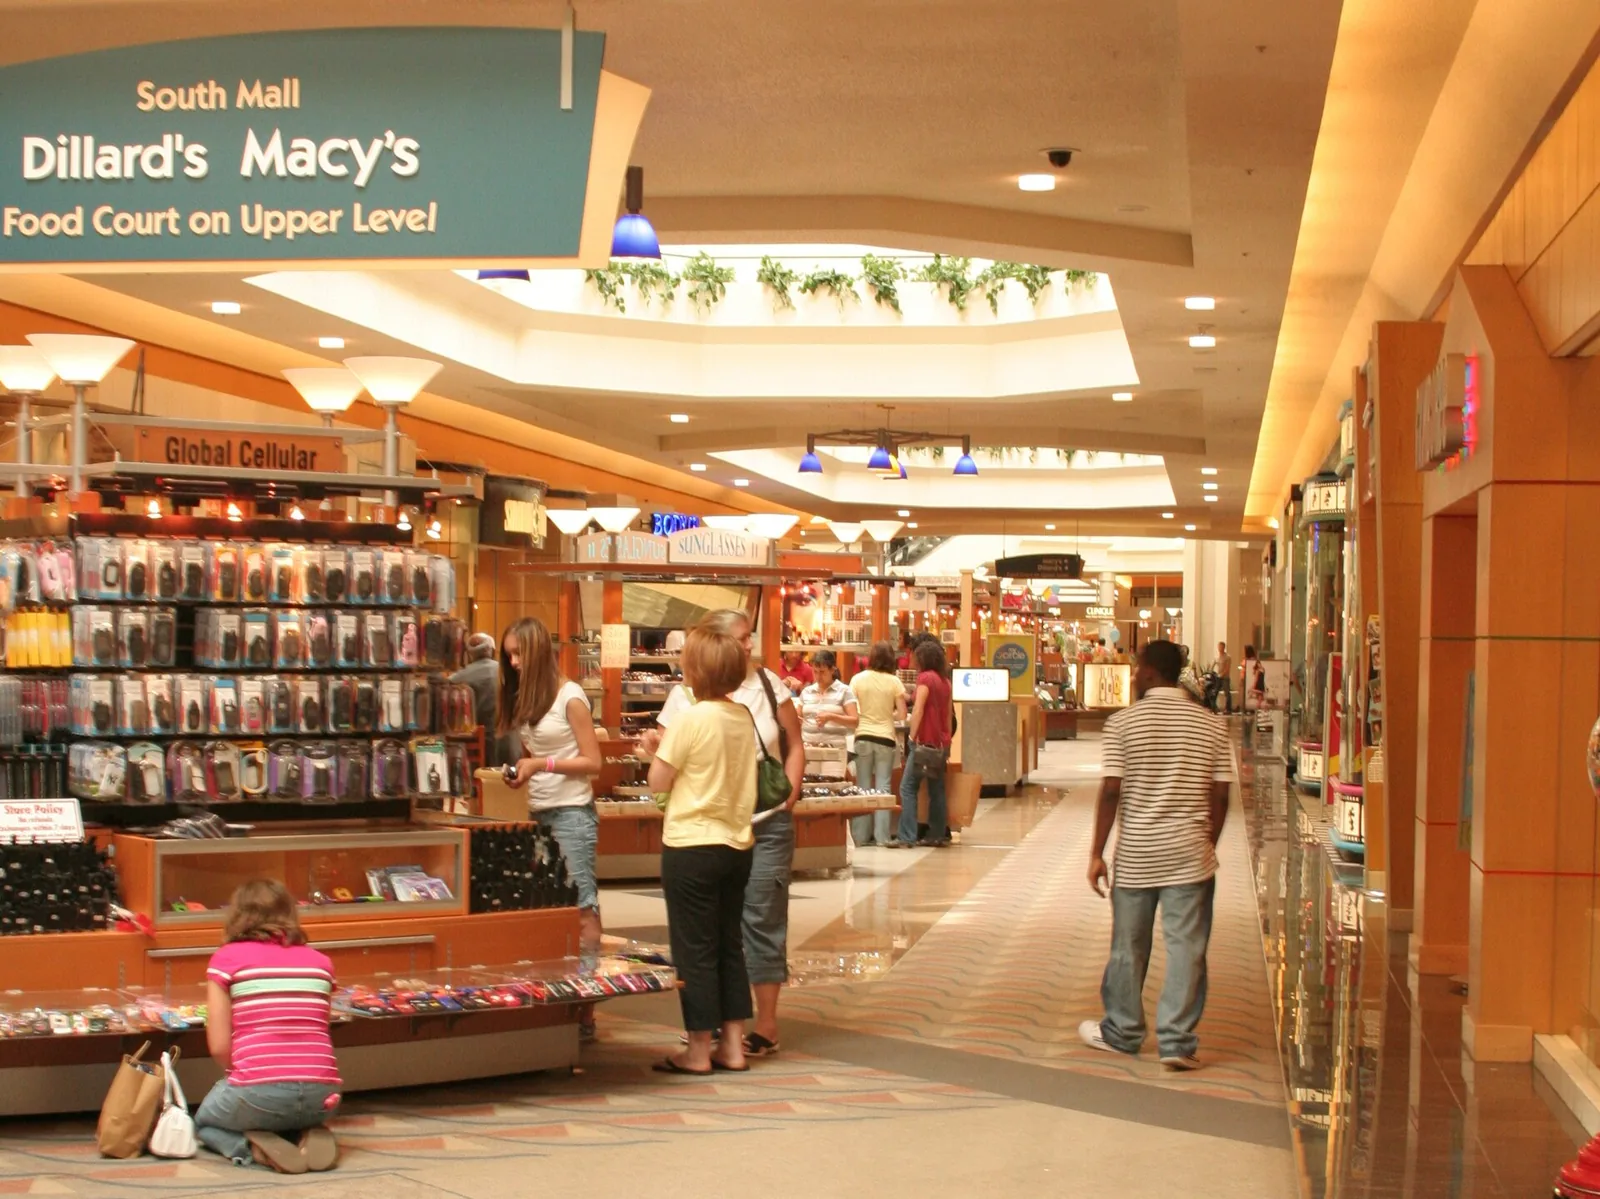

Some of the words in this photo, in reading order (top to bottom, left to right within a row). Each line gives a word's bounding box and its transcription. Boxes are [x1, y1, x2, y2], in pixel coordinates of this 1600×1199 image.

[136, 79, 228, 112] South
[235, 77, 300, 109] Mall
[22, 133, 209, 180] Dillard's
[239, 127, 421, 188] Macy's
[3, 205, 85, 237] Food
[92, 205, 181, 237] Court
[188, 210, 231, 236] on
[240, 203, 344, 240] Upper
[352, 201, 438, 234] Level
[165, 435, 232, 467] Global
[239, 439, 318, 471] Cellular
[678, 531, 746, 558] SUNGLASSES
[4, 804, 31, 815] Store
[34, 803, 63, 815] Policy
